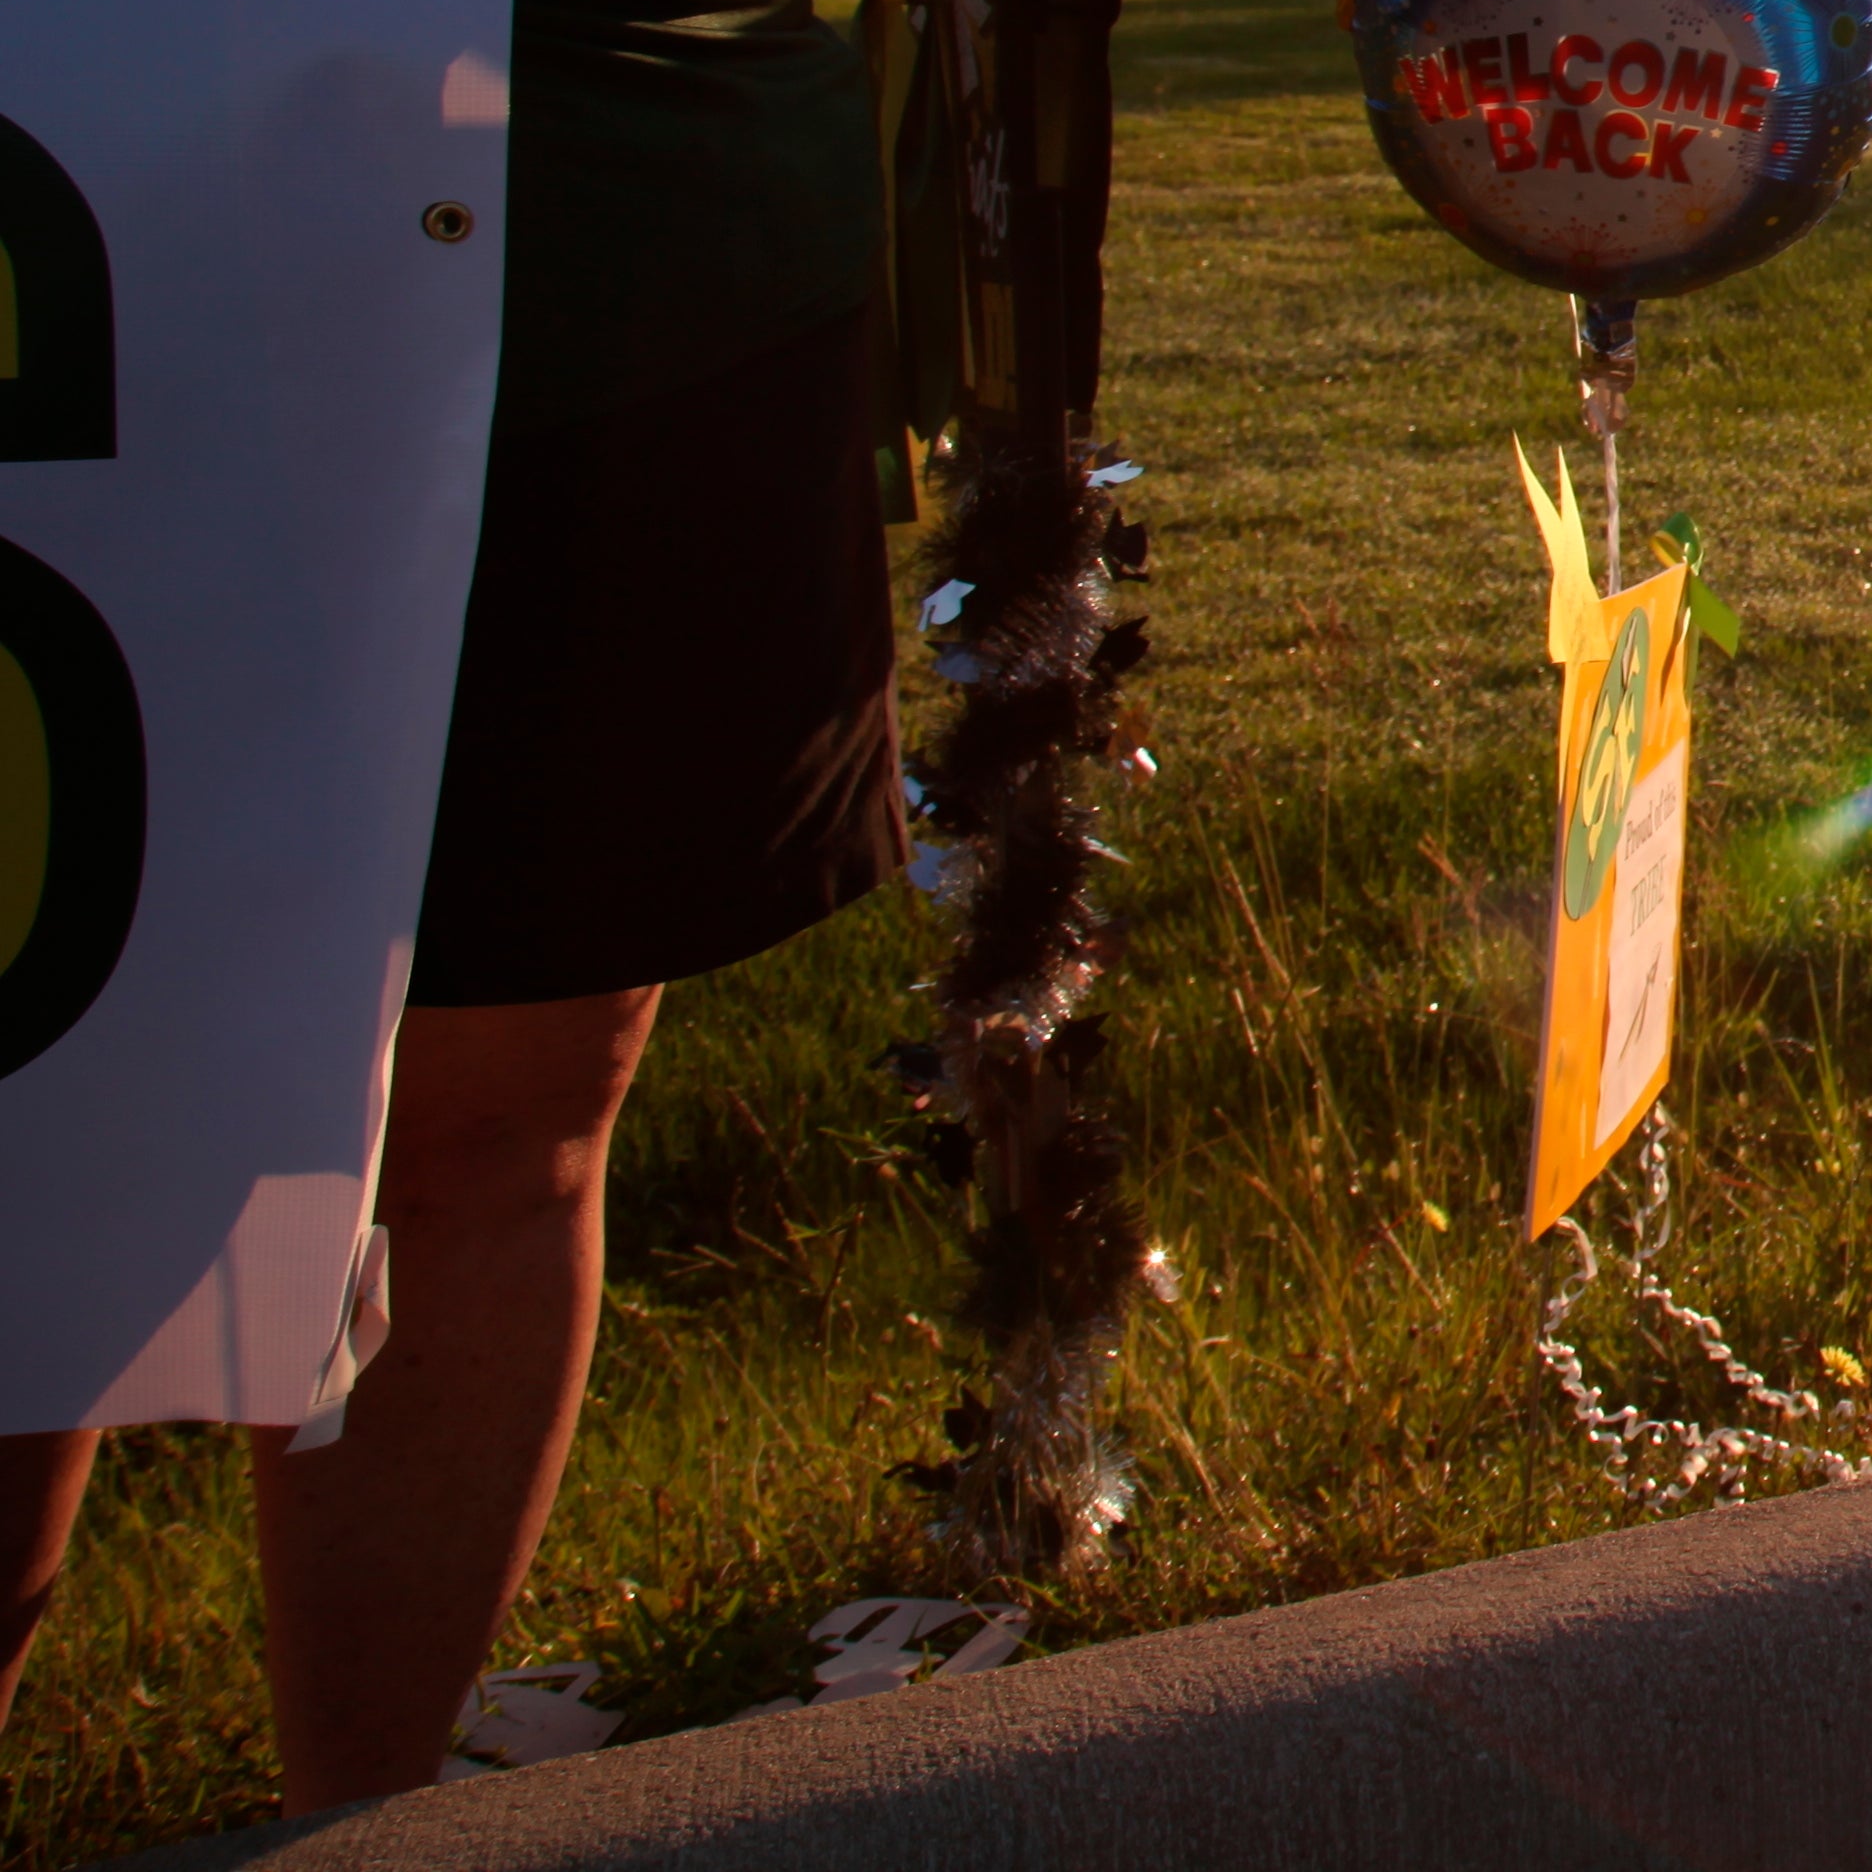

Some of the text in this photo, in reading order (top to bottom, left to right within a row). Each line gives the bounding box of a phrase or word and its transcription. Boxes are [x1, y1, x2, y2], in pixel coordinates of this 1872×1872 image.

[1400, 32, 1781, 134] WELCOME
[1483, 102, 1701, 184] BACK
[1630, 853, 1668, 938] TRIBE
